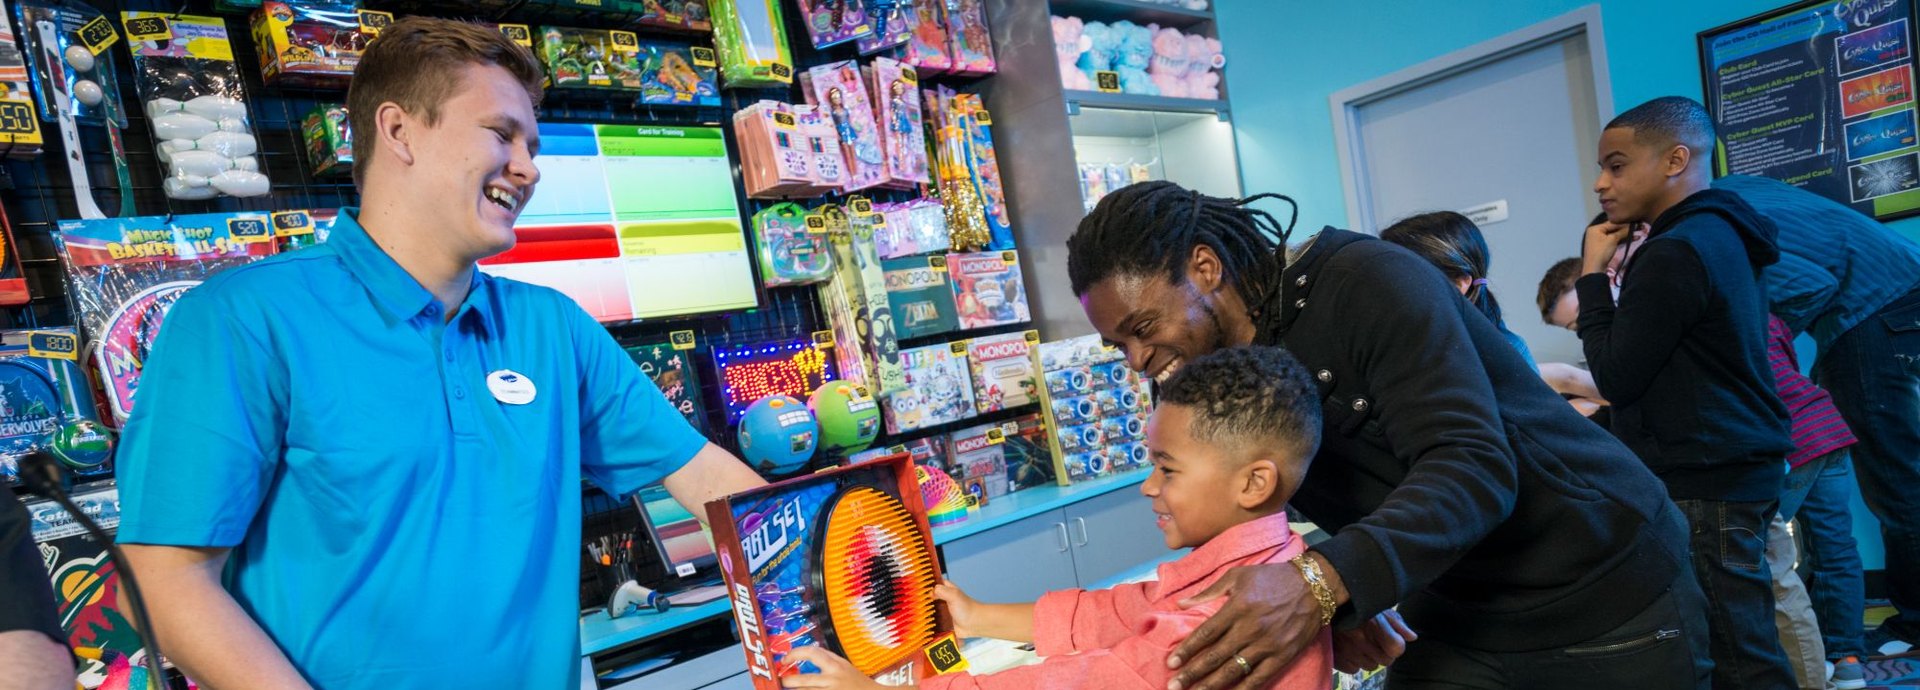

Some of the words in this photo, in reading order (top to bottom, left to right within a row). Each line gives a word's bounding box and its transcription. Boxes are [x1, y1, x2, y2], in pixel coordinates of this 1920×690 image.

[136, 20, 158, 33] 365
[0, 104, 32, 131] 50
[238, 221, 258, 235] 520
[0, 416, 58, 438] ERWOLVES
[956, 436, 990, 452] MONOPO
